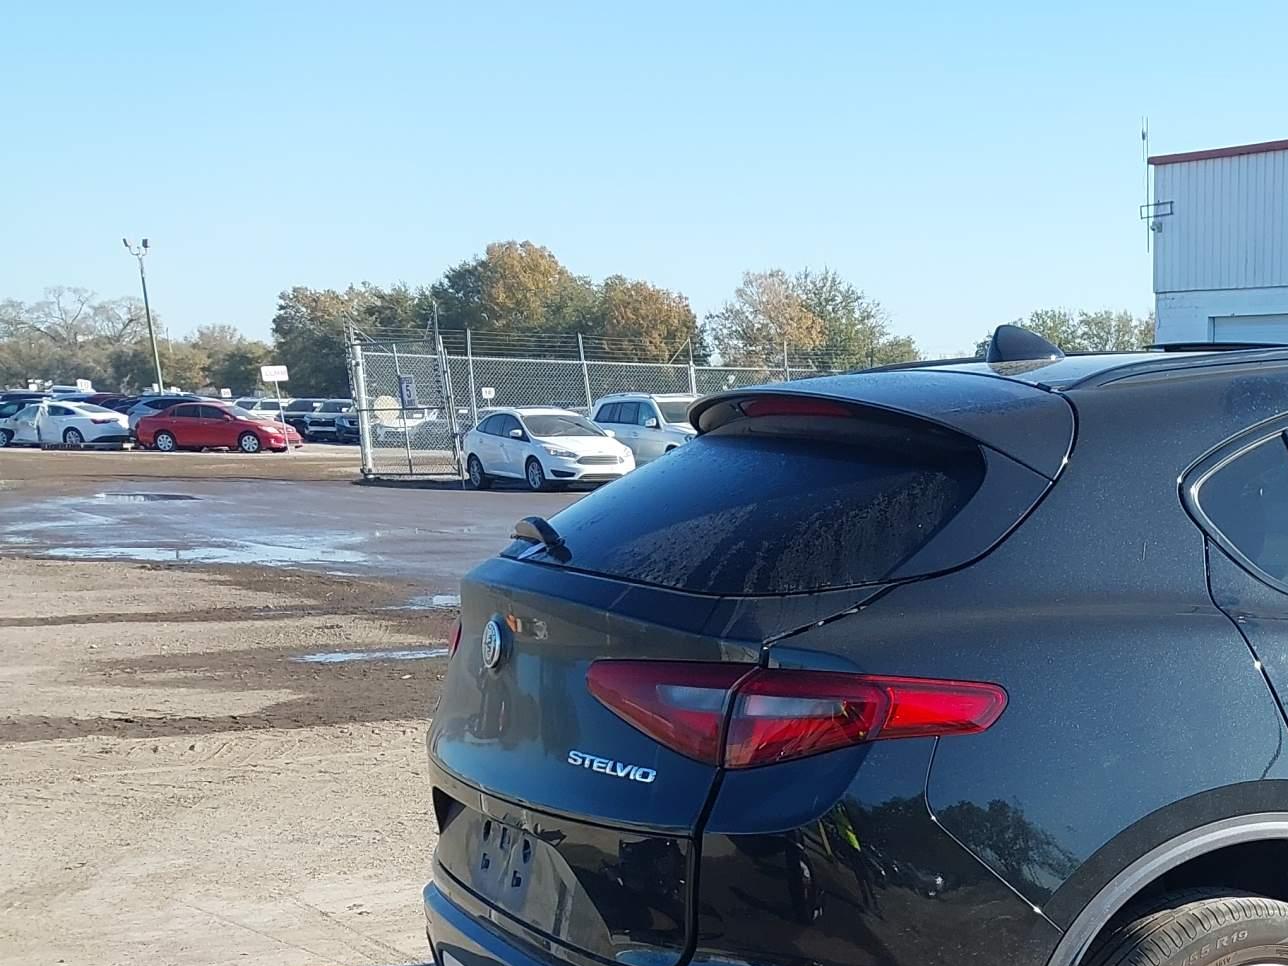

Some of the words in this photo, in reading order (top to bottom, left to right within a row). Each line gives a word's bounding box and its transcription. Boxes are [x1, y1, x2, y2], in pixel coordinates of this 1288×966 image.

[405, 384, 412, 399] 5
[567, 750, 657, 783] STELVIO
[1215, 930, 1249, 950] R19
